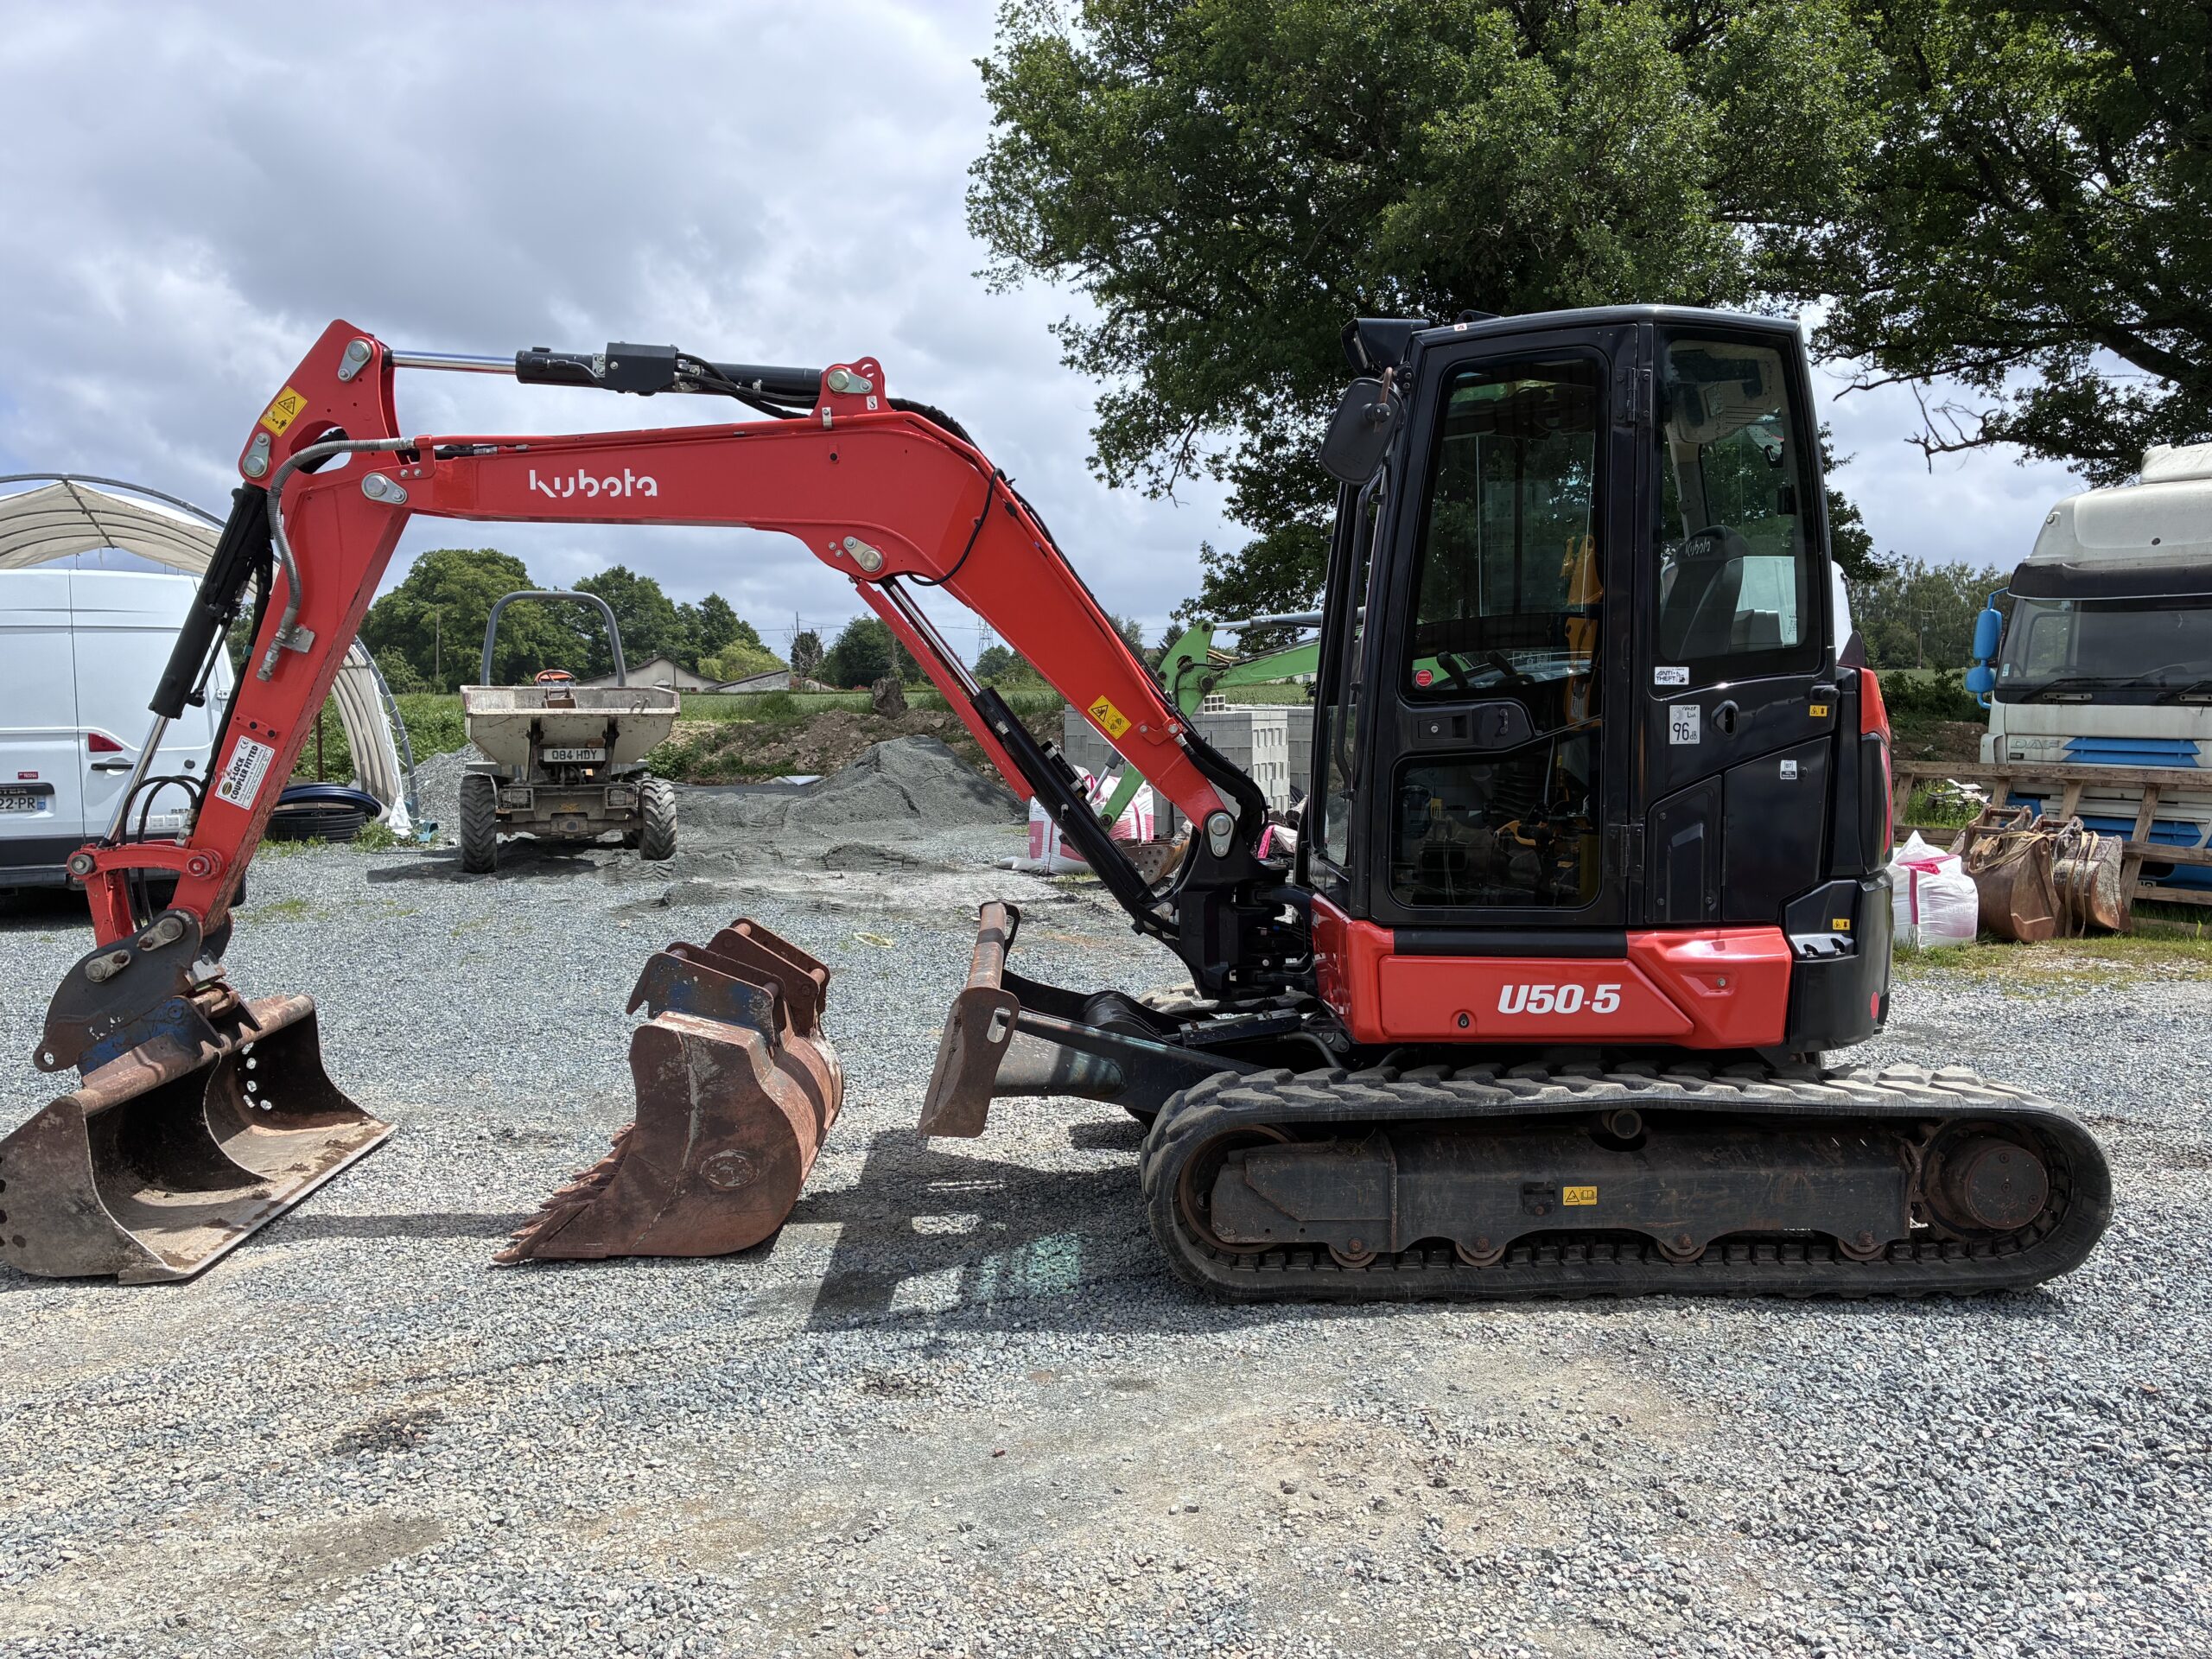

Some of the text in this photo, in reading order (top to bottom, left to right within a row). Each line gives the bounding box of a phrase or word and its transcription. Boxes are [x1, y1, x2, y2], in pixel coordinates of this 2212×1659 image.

[1673, 722, 1697, 741] 96 dB
[2011, 739, 2060, 749] DAF
[576, 750, 596, 760] HDY
[230, 757, 245, 781] S-LOCK
[231, 746, 257, 799] COUPLER FITTED
[1497, 984, 1621, 1014] U50-5
